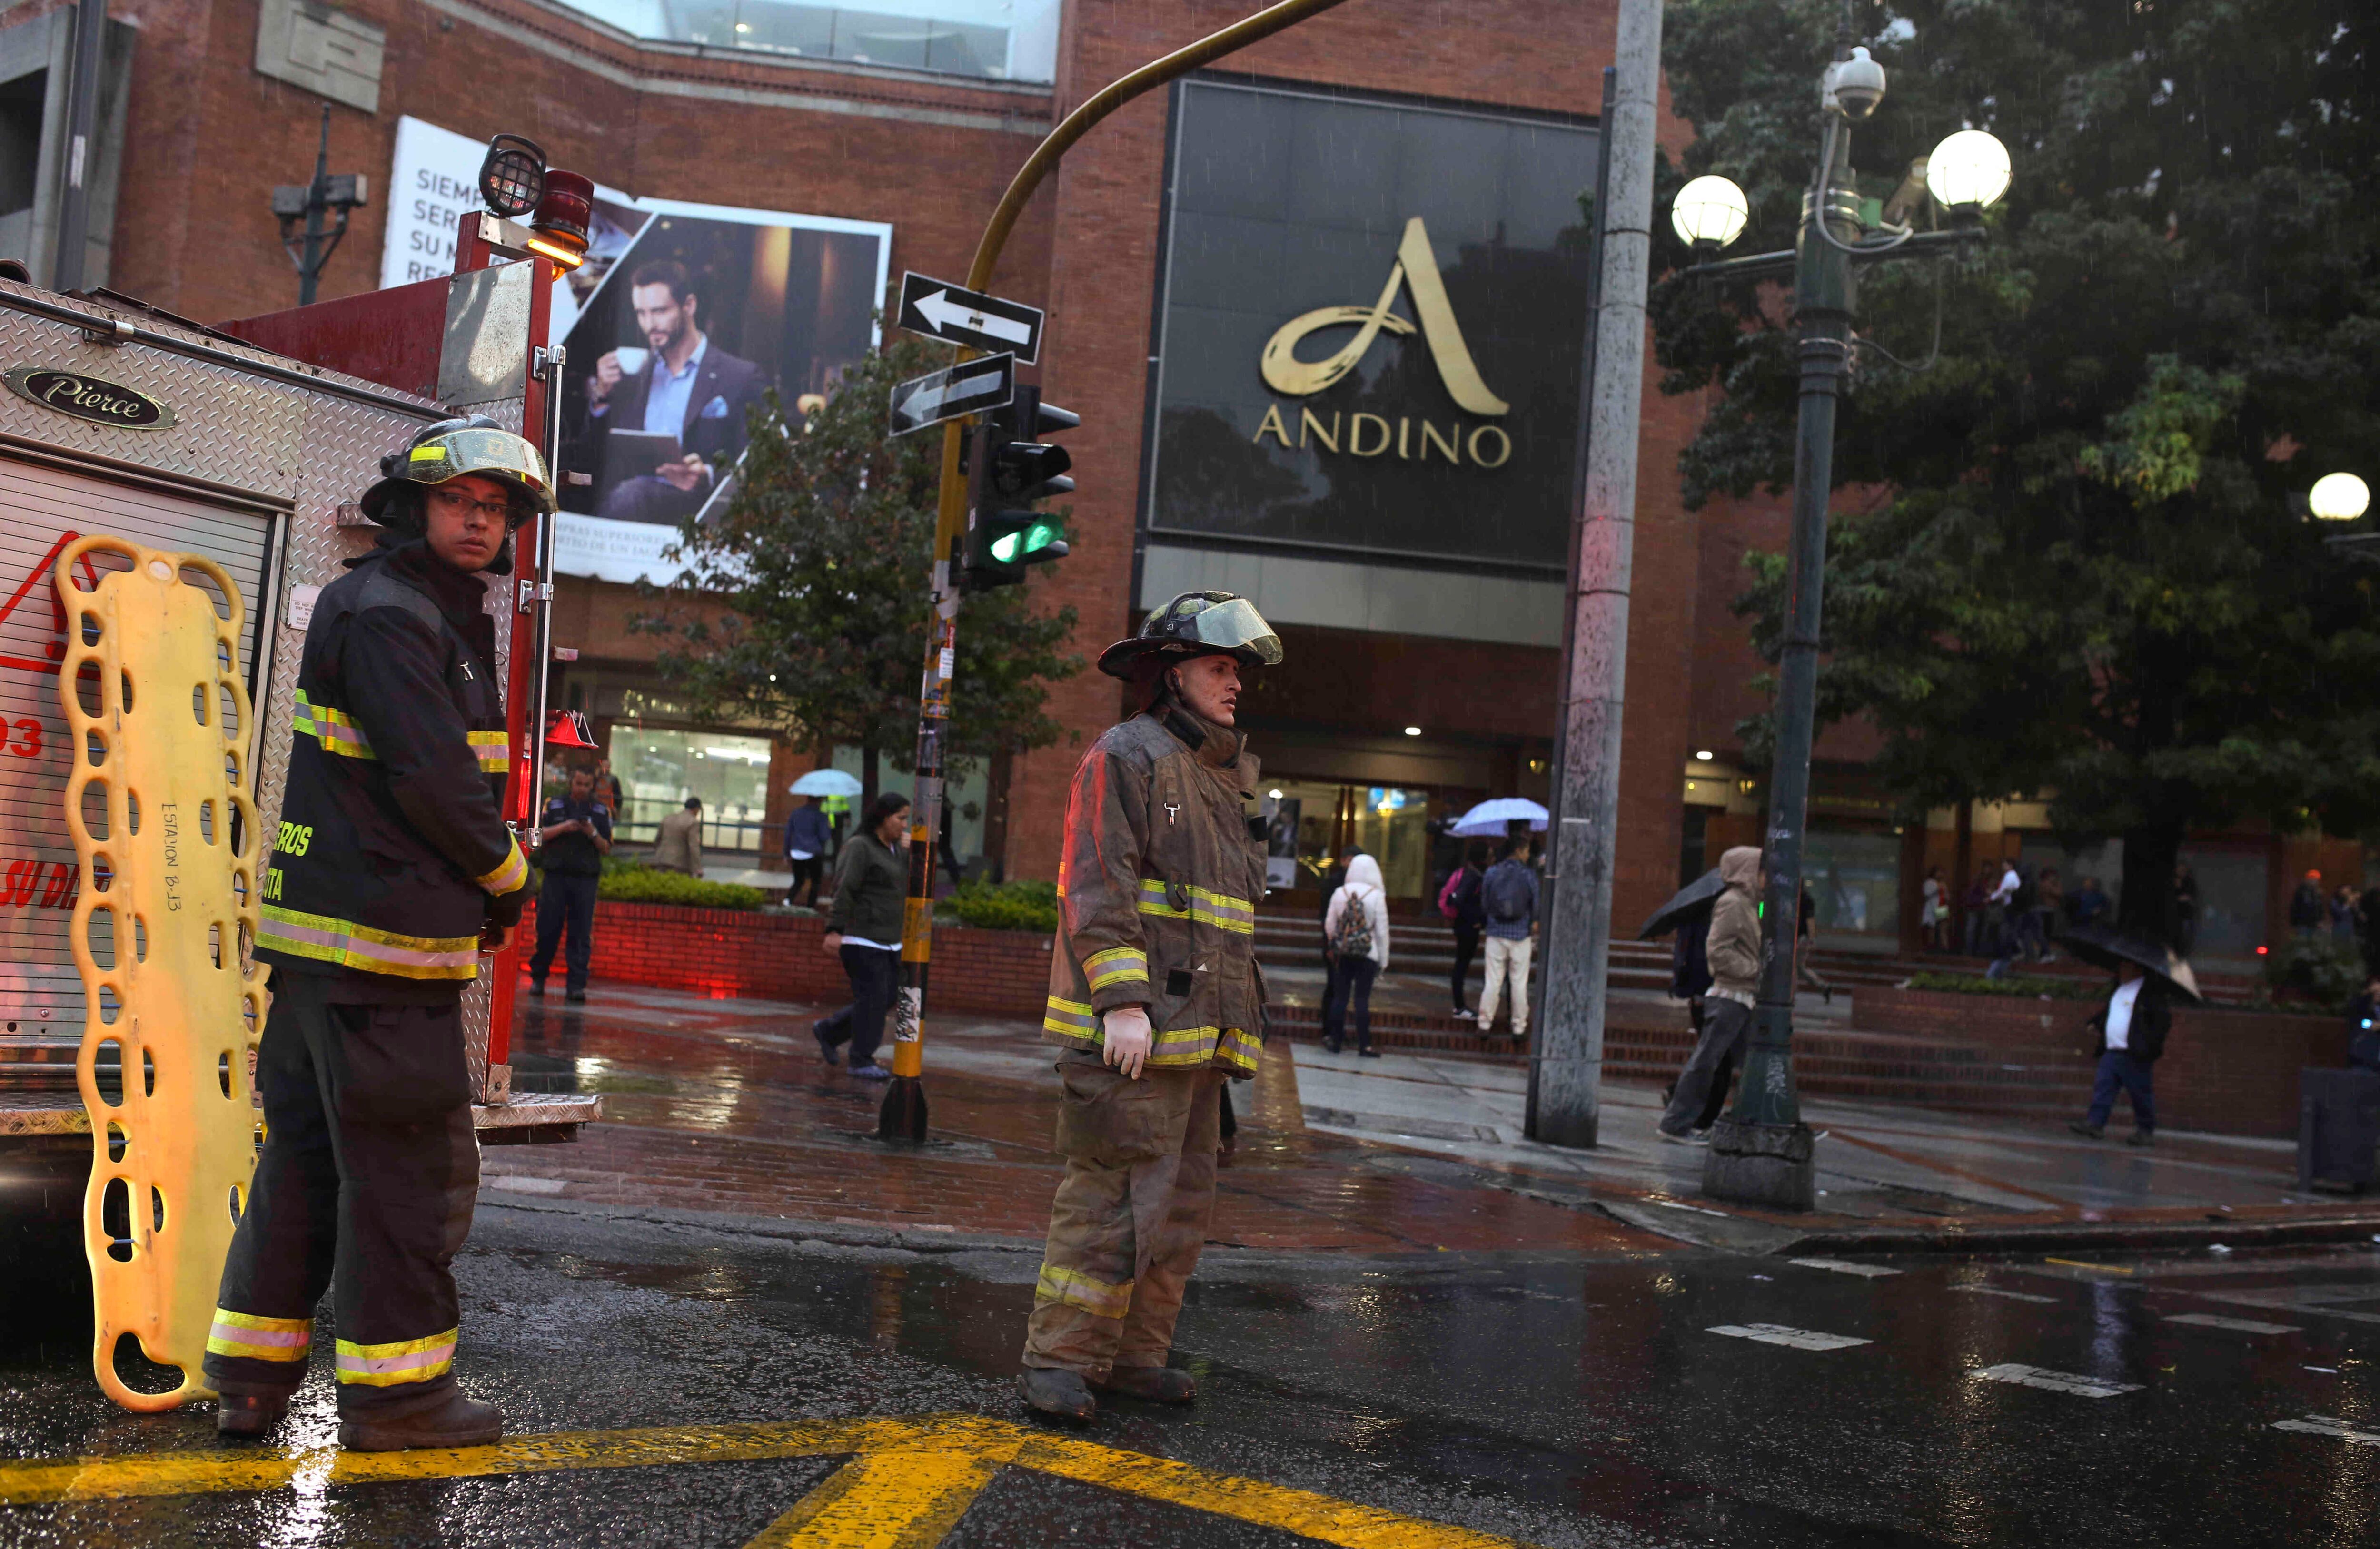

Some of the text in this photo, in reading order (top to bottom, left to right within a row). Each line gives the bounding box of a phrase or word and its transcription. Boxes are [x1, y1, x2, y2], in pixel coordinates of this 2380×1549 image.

[413, 198, 458, 231] SER
[410, 230, 439, 256] SU
[43, 376, 140, 418] Pierce
[1253, 404, 1511, 468] ANDINO
[0, 716, 42, 757] 3
[162, 803, 181, 911] ESTACION B-13
